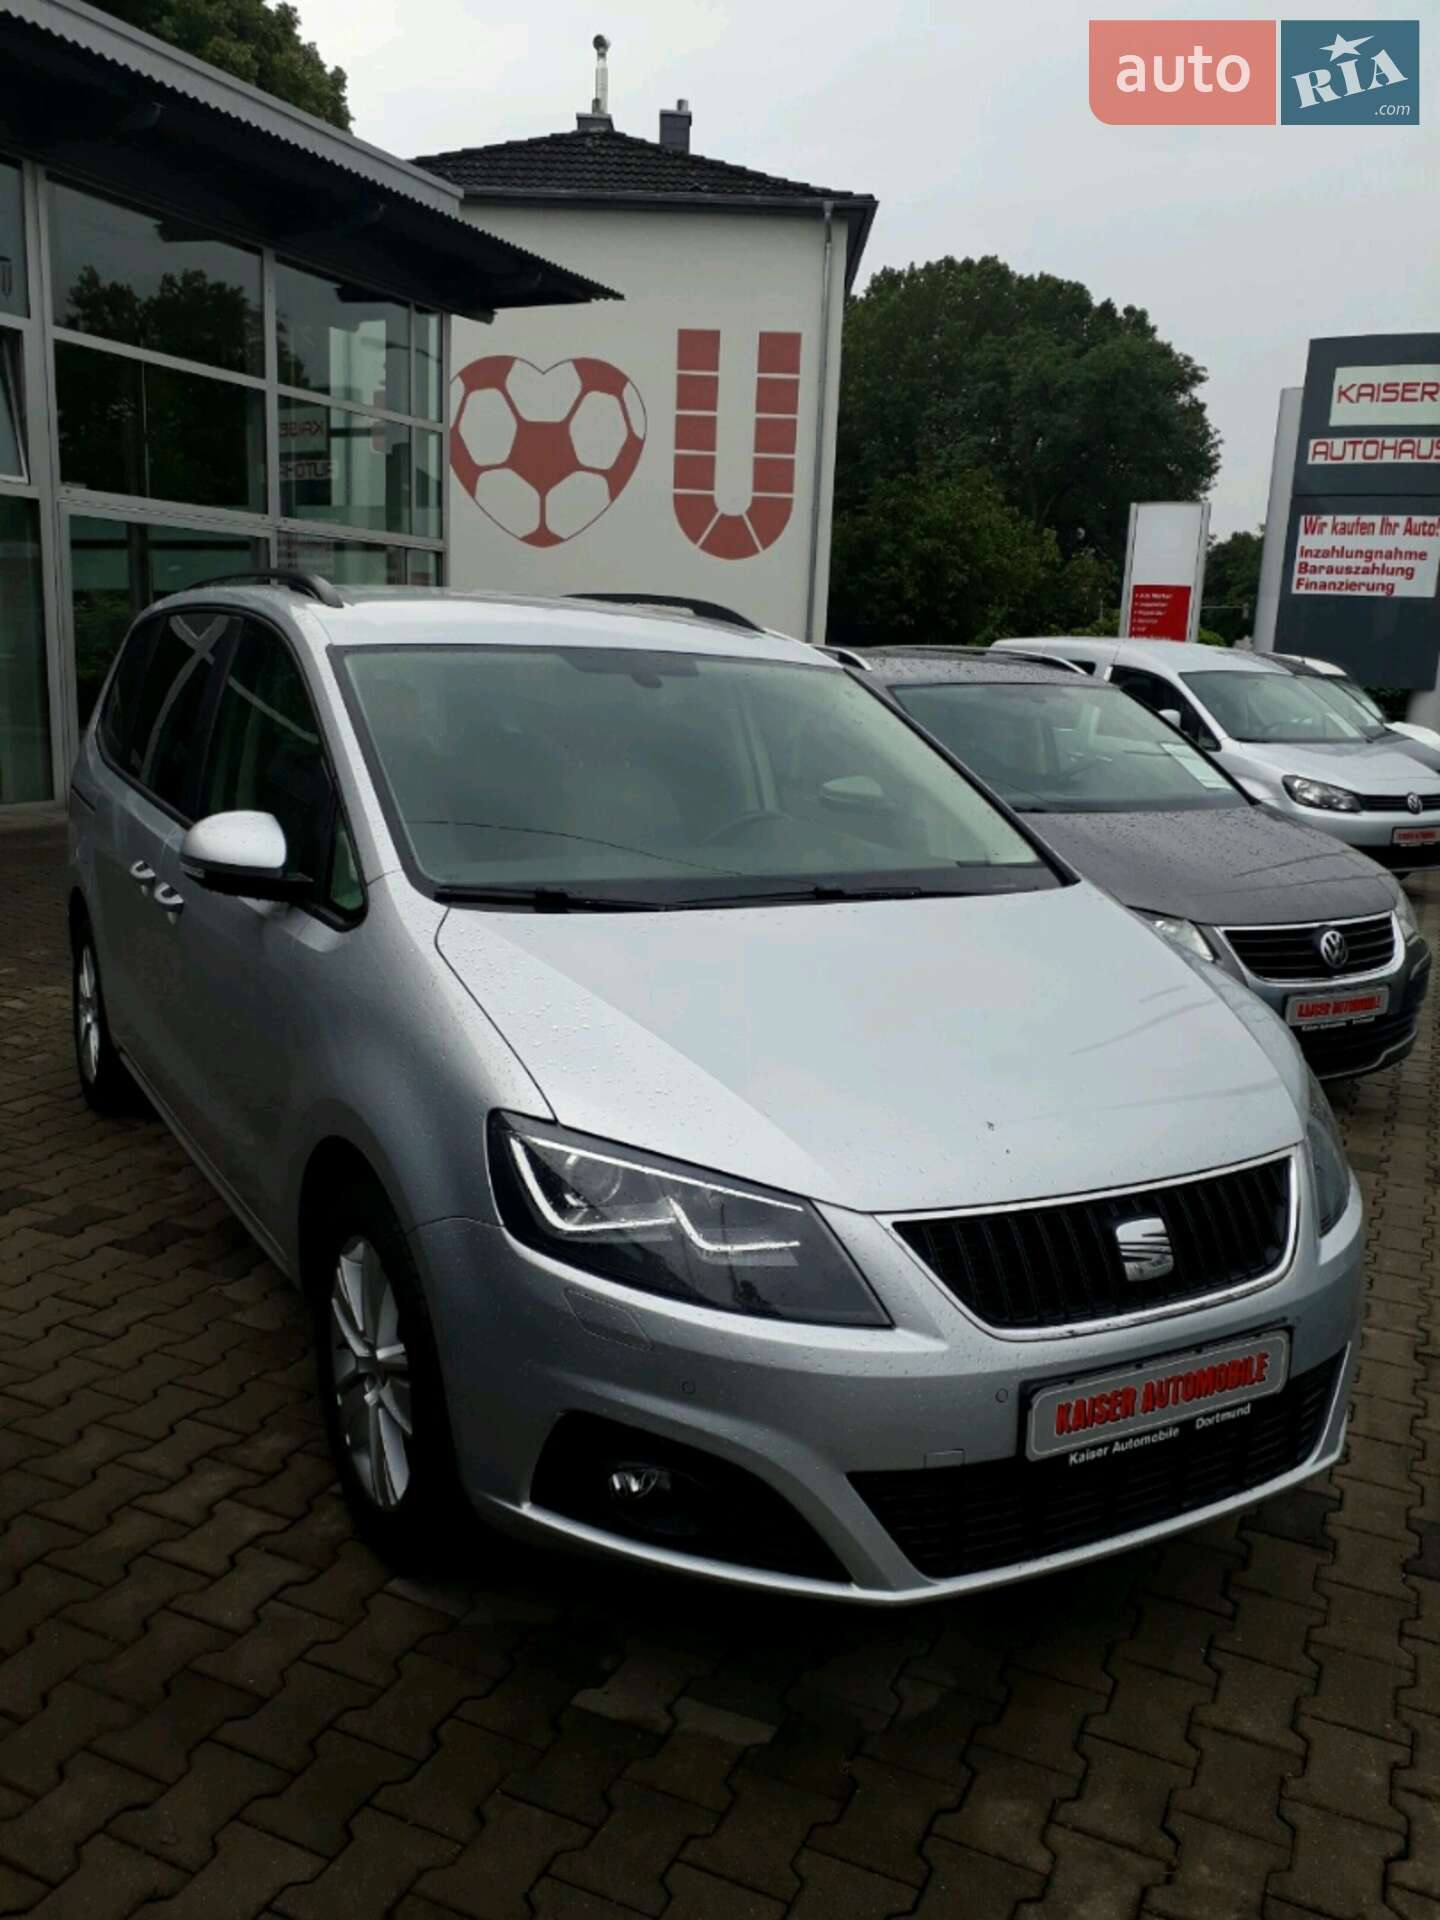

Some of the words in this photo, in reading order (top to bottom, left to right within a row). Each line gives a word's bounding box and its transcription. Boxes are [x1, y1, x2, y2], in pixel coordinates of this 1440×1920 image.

[1337, 382, 1440, 404] KAISER
[1303, 515, 1328, 536] Wir
[1331, 515, 1376, 537] kaufen
[1379, 516, 1400, 536] Ihr
[1300, 546, 1428, 562] Inzahlungnahme
[1297, 562, 1415, 580] Barauszahlung
[1295, 578, 1395, 596] Finanzierung
[1054, 1386, 1138, 1436] KAISER
[1140, 1352, 1270, 1415] AUTOMOBILE
[1068, 1445, 1109, 1466] Kaiser
[1112, 1426, 1180, 1454] Automobile
[1195, 1402, 1251, 1430] Dortmund
